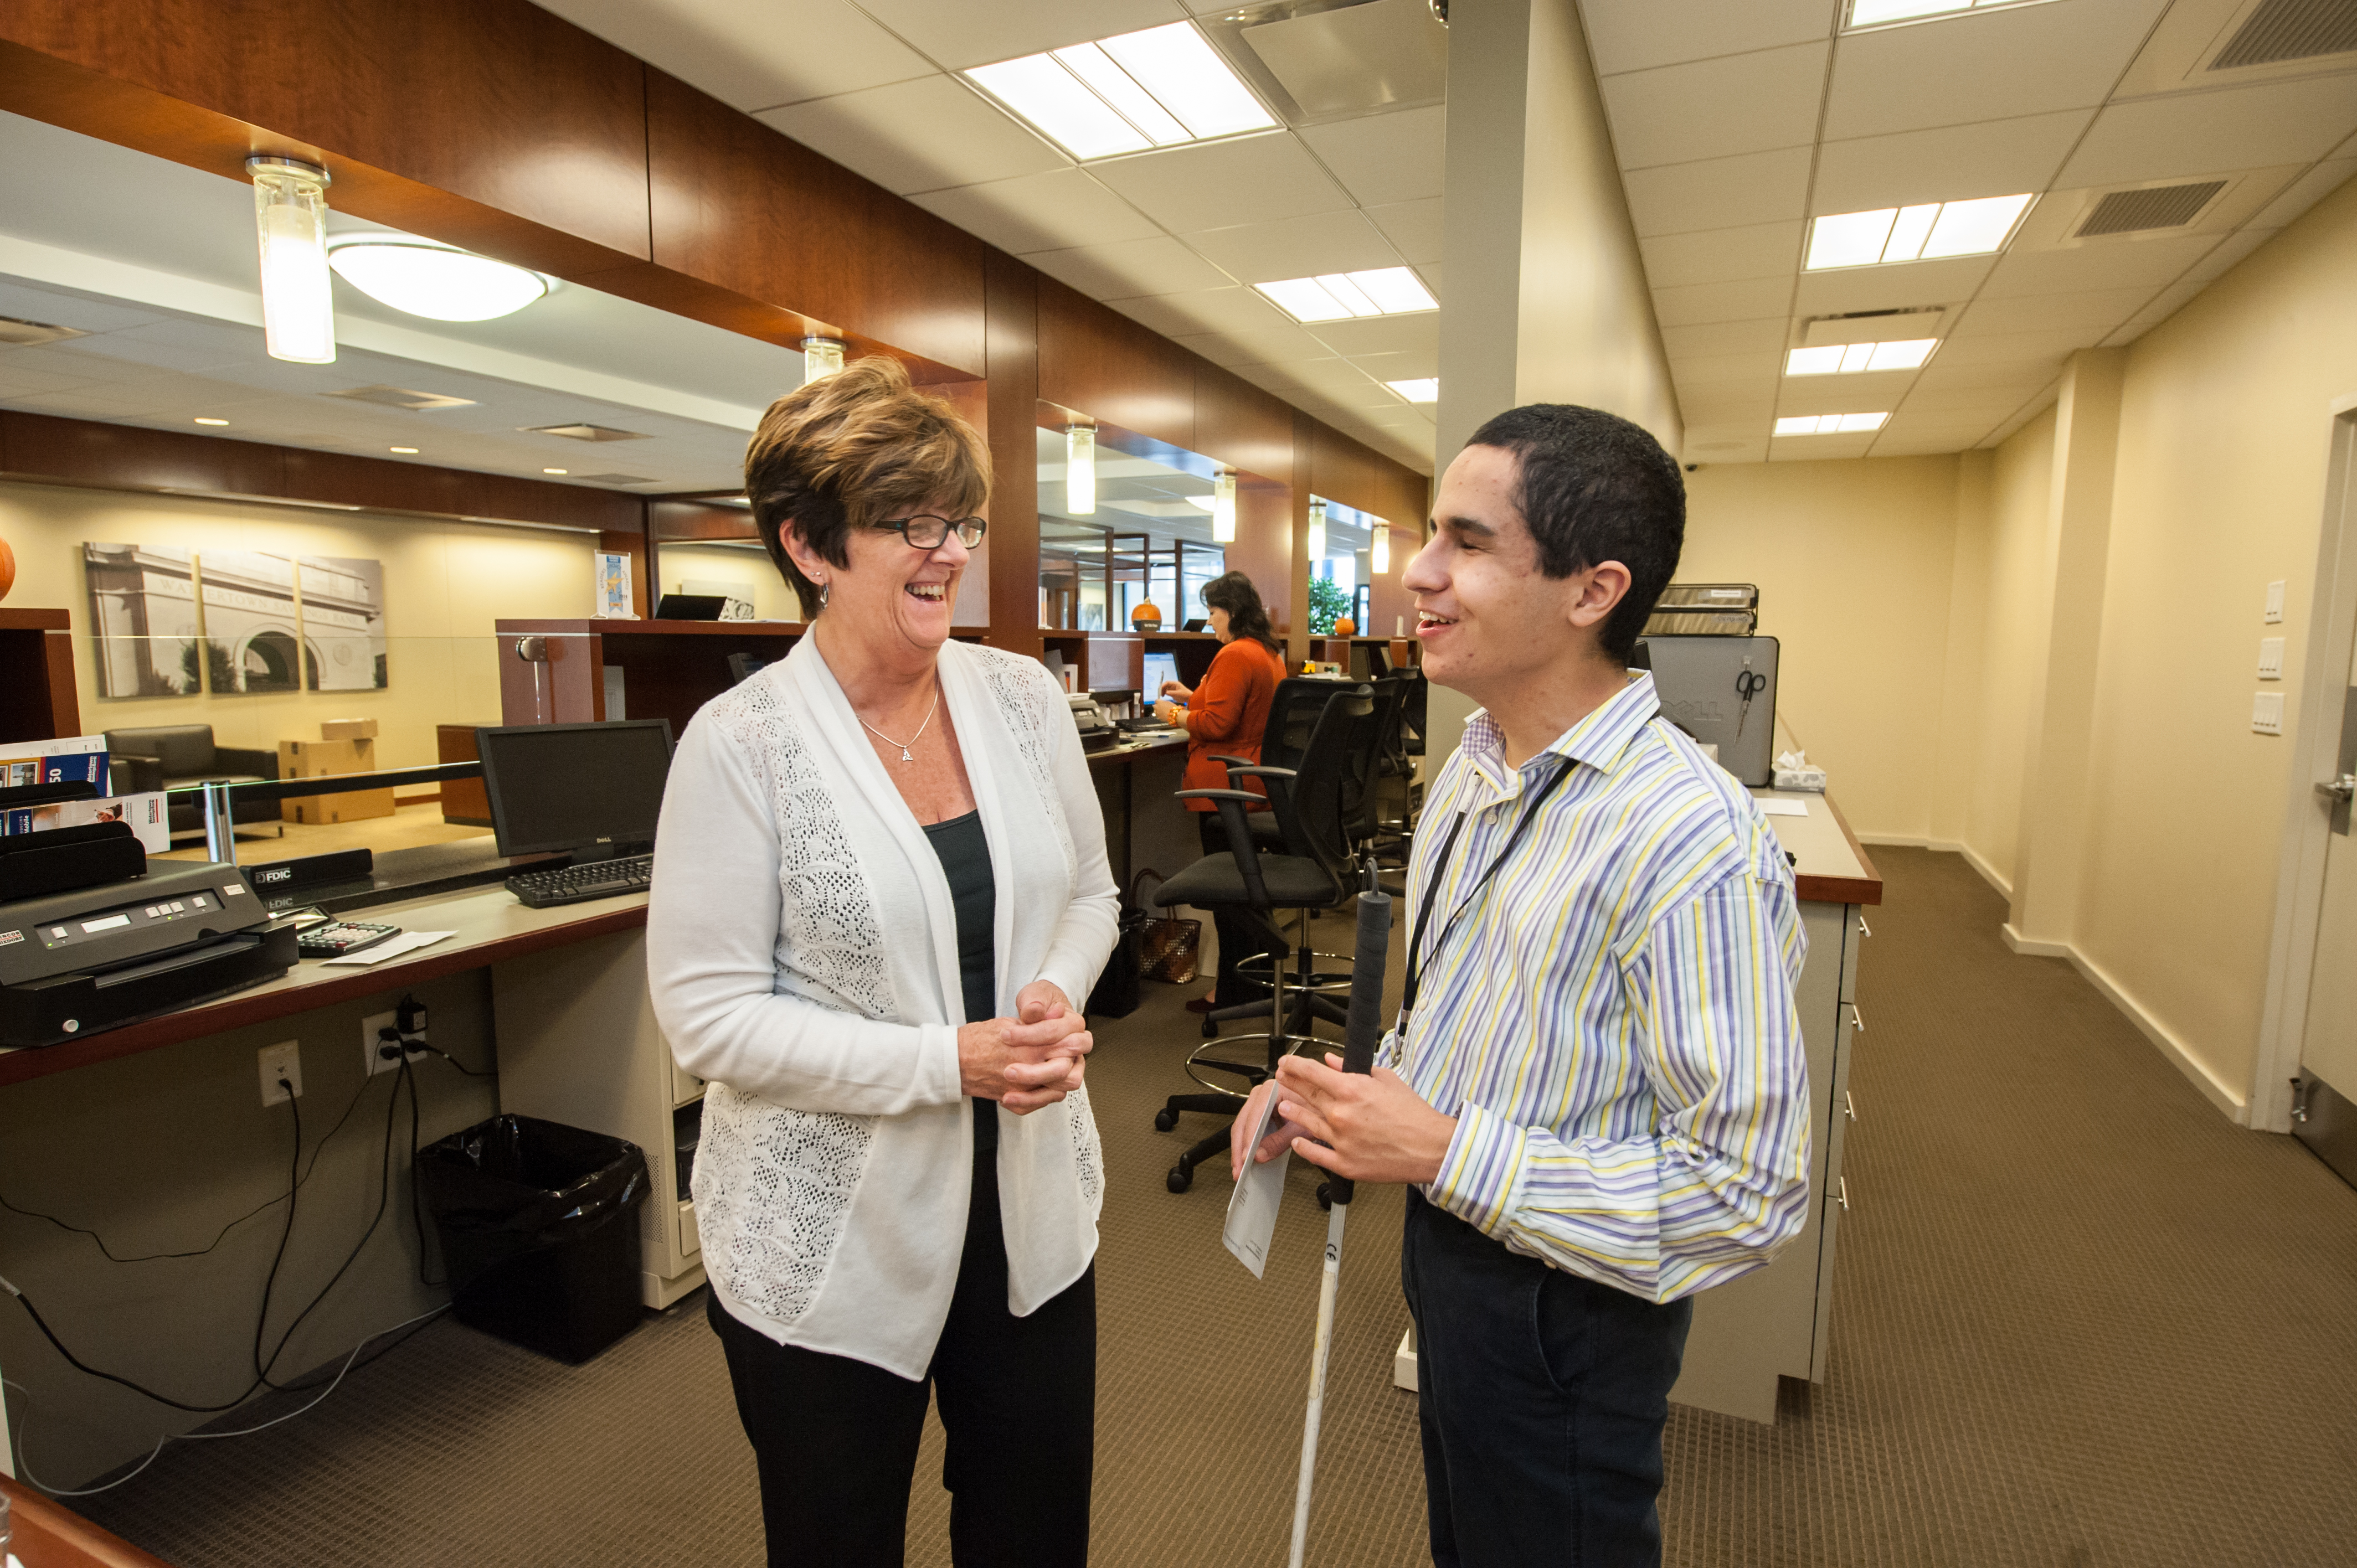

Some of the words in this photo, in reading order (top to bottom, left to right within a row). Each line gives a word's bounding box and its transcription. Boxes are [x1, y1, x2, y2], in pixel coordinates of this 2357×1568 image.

[159, 579, 267, 608] WATERTOWN
[49, 768, 62, 783] 50
[266, 870, 291, 881] FDIC
[0, 936, 22, 945] IXDORF
[1326, 1243, 1337, 1260] CE
